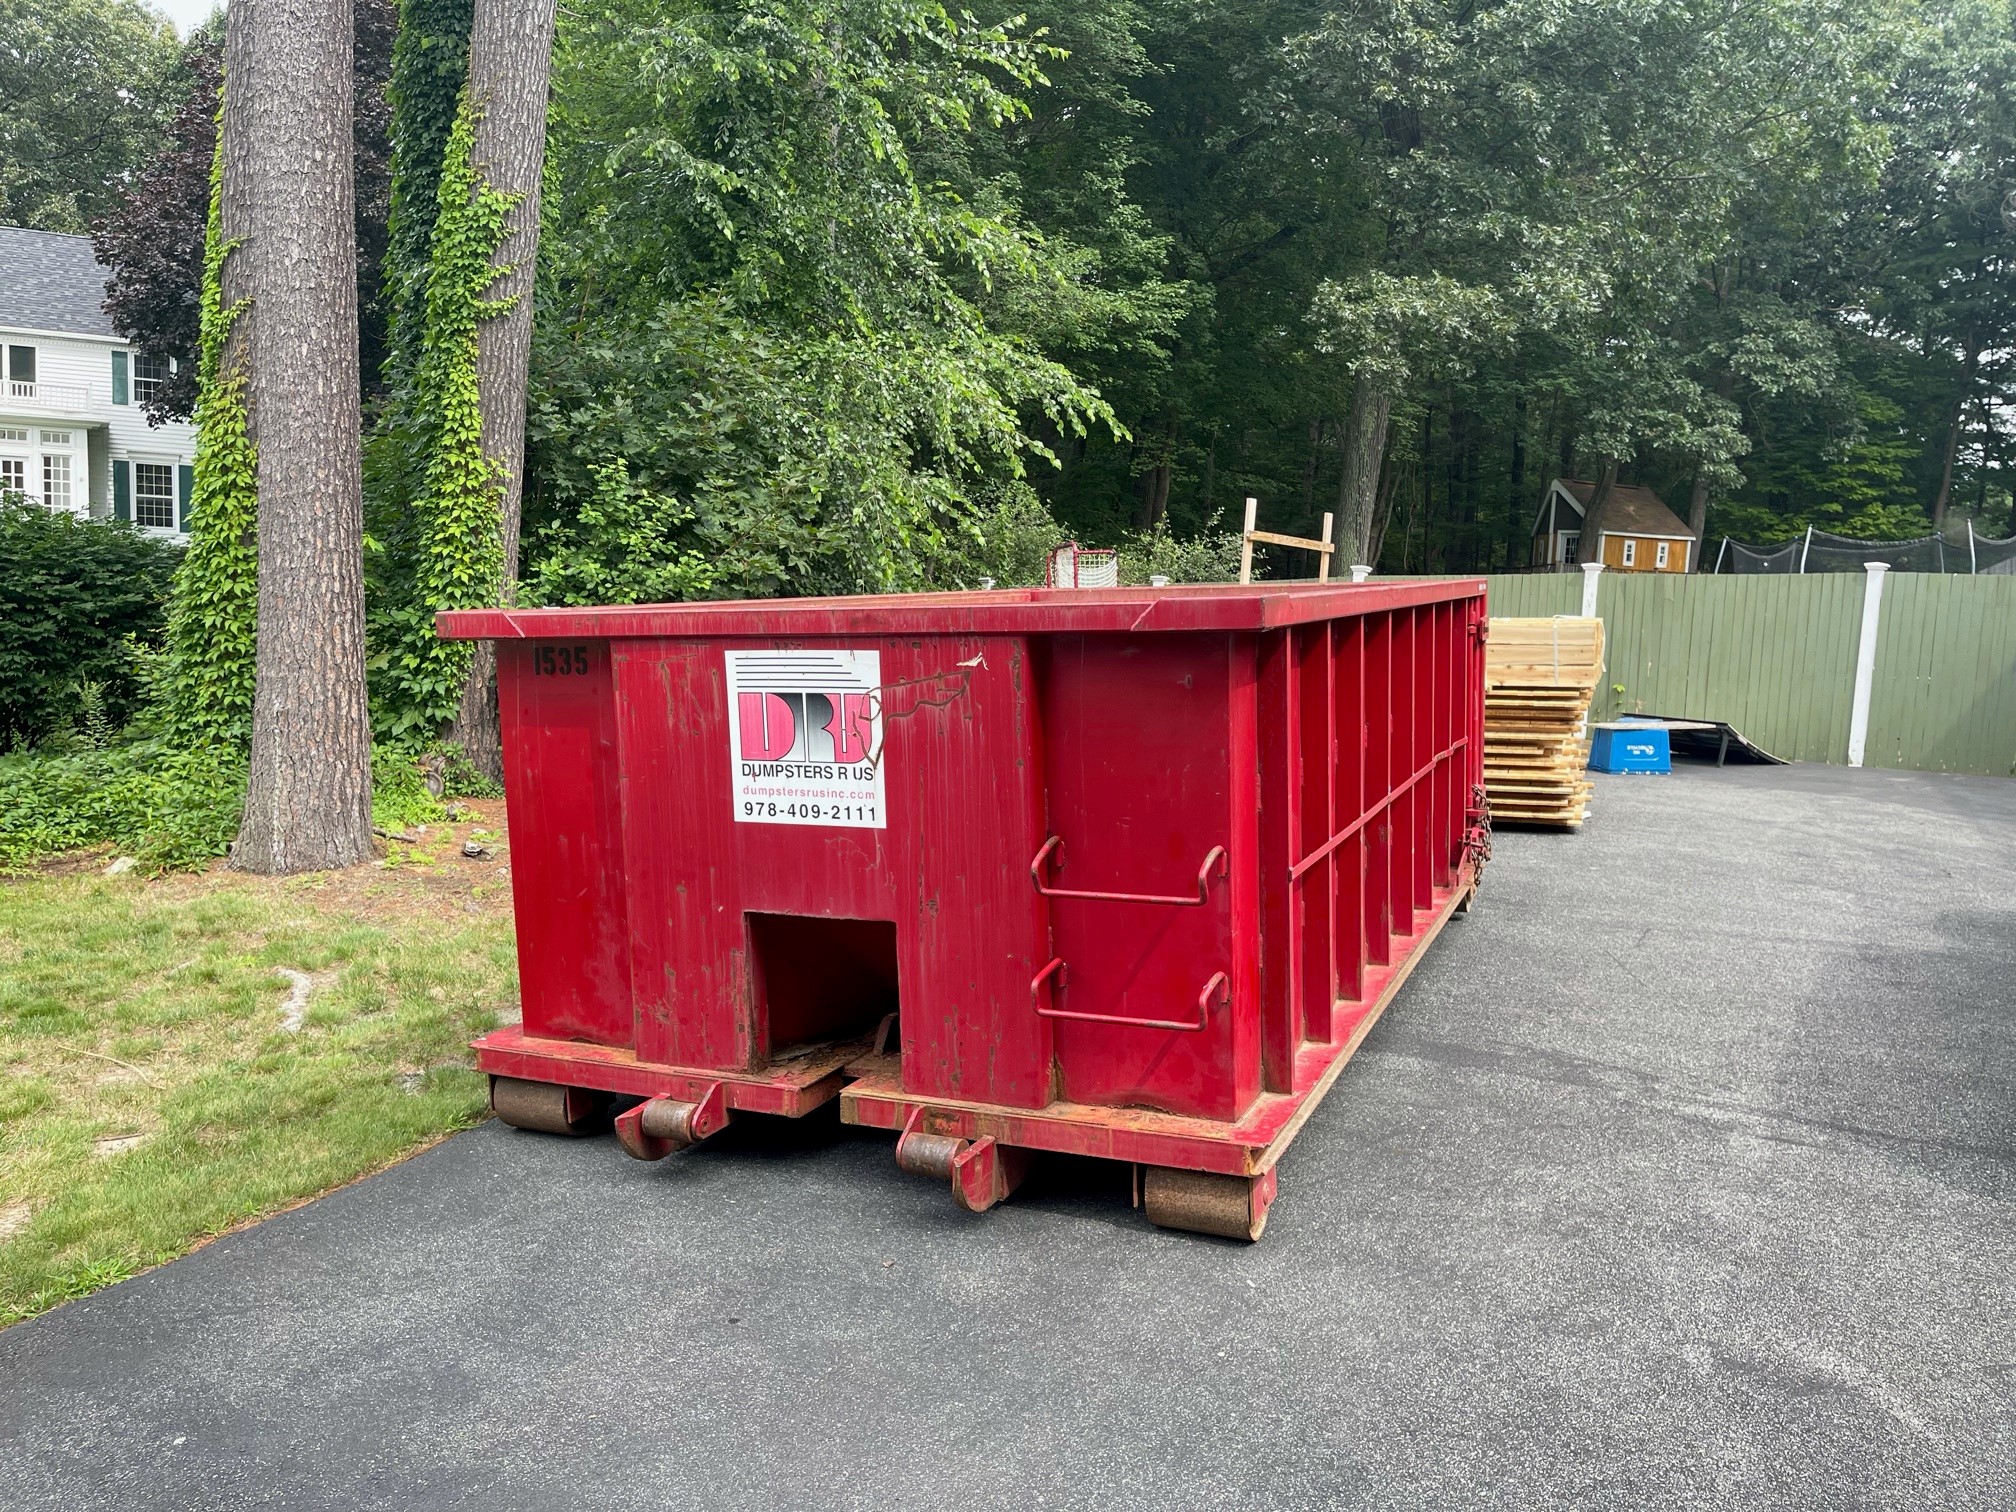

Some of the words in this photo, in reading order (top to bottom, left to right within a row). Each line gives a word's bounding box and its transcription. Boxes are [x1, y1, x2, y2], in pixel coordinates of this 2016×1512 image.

[534, 646, 588, 676] 1535
[741, 763, 834, 780] DUMPSTERS
[838, 766, 848, 780] R
[853, 766, 874, 781] US
[742, 785, 875, 800] dumpstersrusinc.com
[744, 801, 876, 821] 978-409-2111
